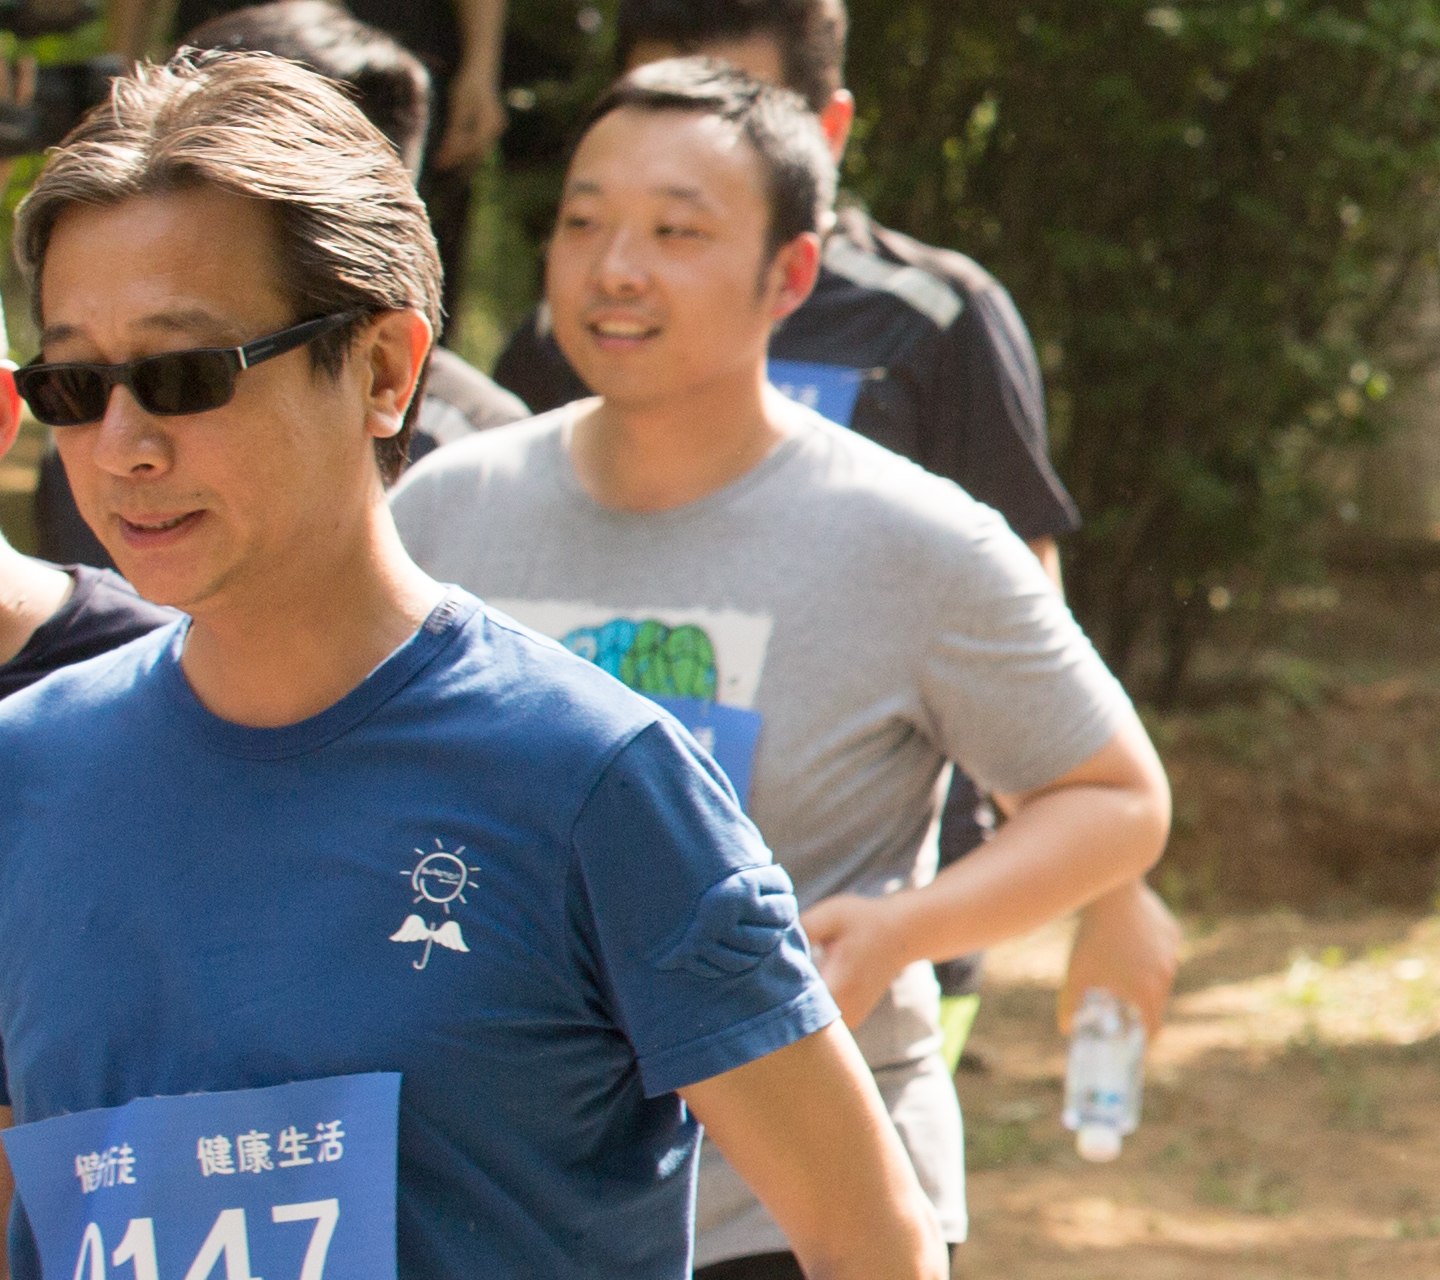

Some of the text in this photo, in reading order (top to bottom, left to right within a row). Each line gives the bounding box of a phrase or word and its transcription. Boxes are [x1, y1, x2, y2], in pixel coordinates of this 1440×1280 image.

[74, 1119, 346, 1194] 健行走 健康生活
